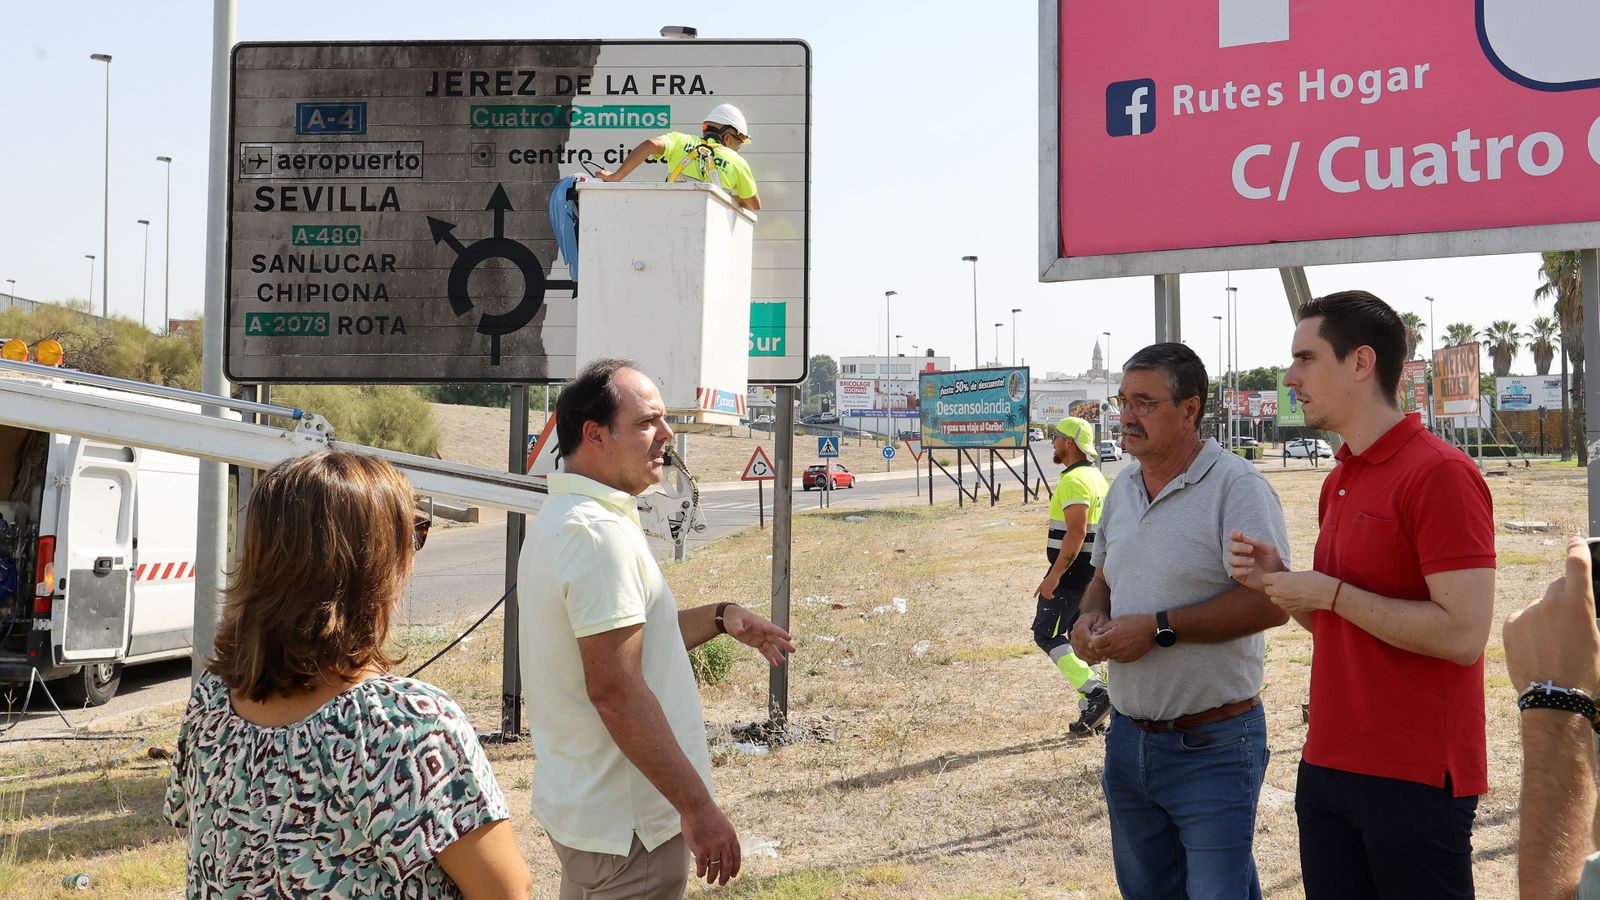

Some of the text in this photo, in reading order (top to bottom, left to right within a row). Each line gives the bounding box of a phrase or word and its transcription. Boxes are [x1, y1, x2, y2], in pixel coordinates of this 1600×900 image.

[425, 71, 714, 96] JEREZ DE LA FRA.
[1173, 79, 1284, 116] Rutes
[1300, 63, 1430, 104] Hogar
[306, 108, 355, 129] A-4
[472, 106, 669, 127] Cuatro Caminos
[277, 150, 420, 173] aeropuerto
[508, 145, 592, 165] centro
[1231, 141, 1301, 202] C/
[1318, 128, 1564, 194] Cuatro
[253, 186, 401, 212] SEVILLA
[294, 227, 359, 245] A-480
[250, 253, 397, 273] SANLUCAR
[257, 283, 390, 303] CHIPIONA
[249, 315, 407, 335] A-2078 ROTA
[1443, 344, 1477, 377] METRO
[955, 379, 970, 393] 50%
[970, 382, 977, 391] de
[937, 398, 1011, 416] Descansolandia
[947, 425, 958, 433] gana
[966, 423, 979, 433] viaje
